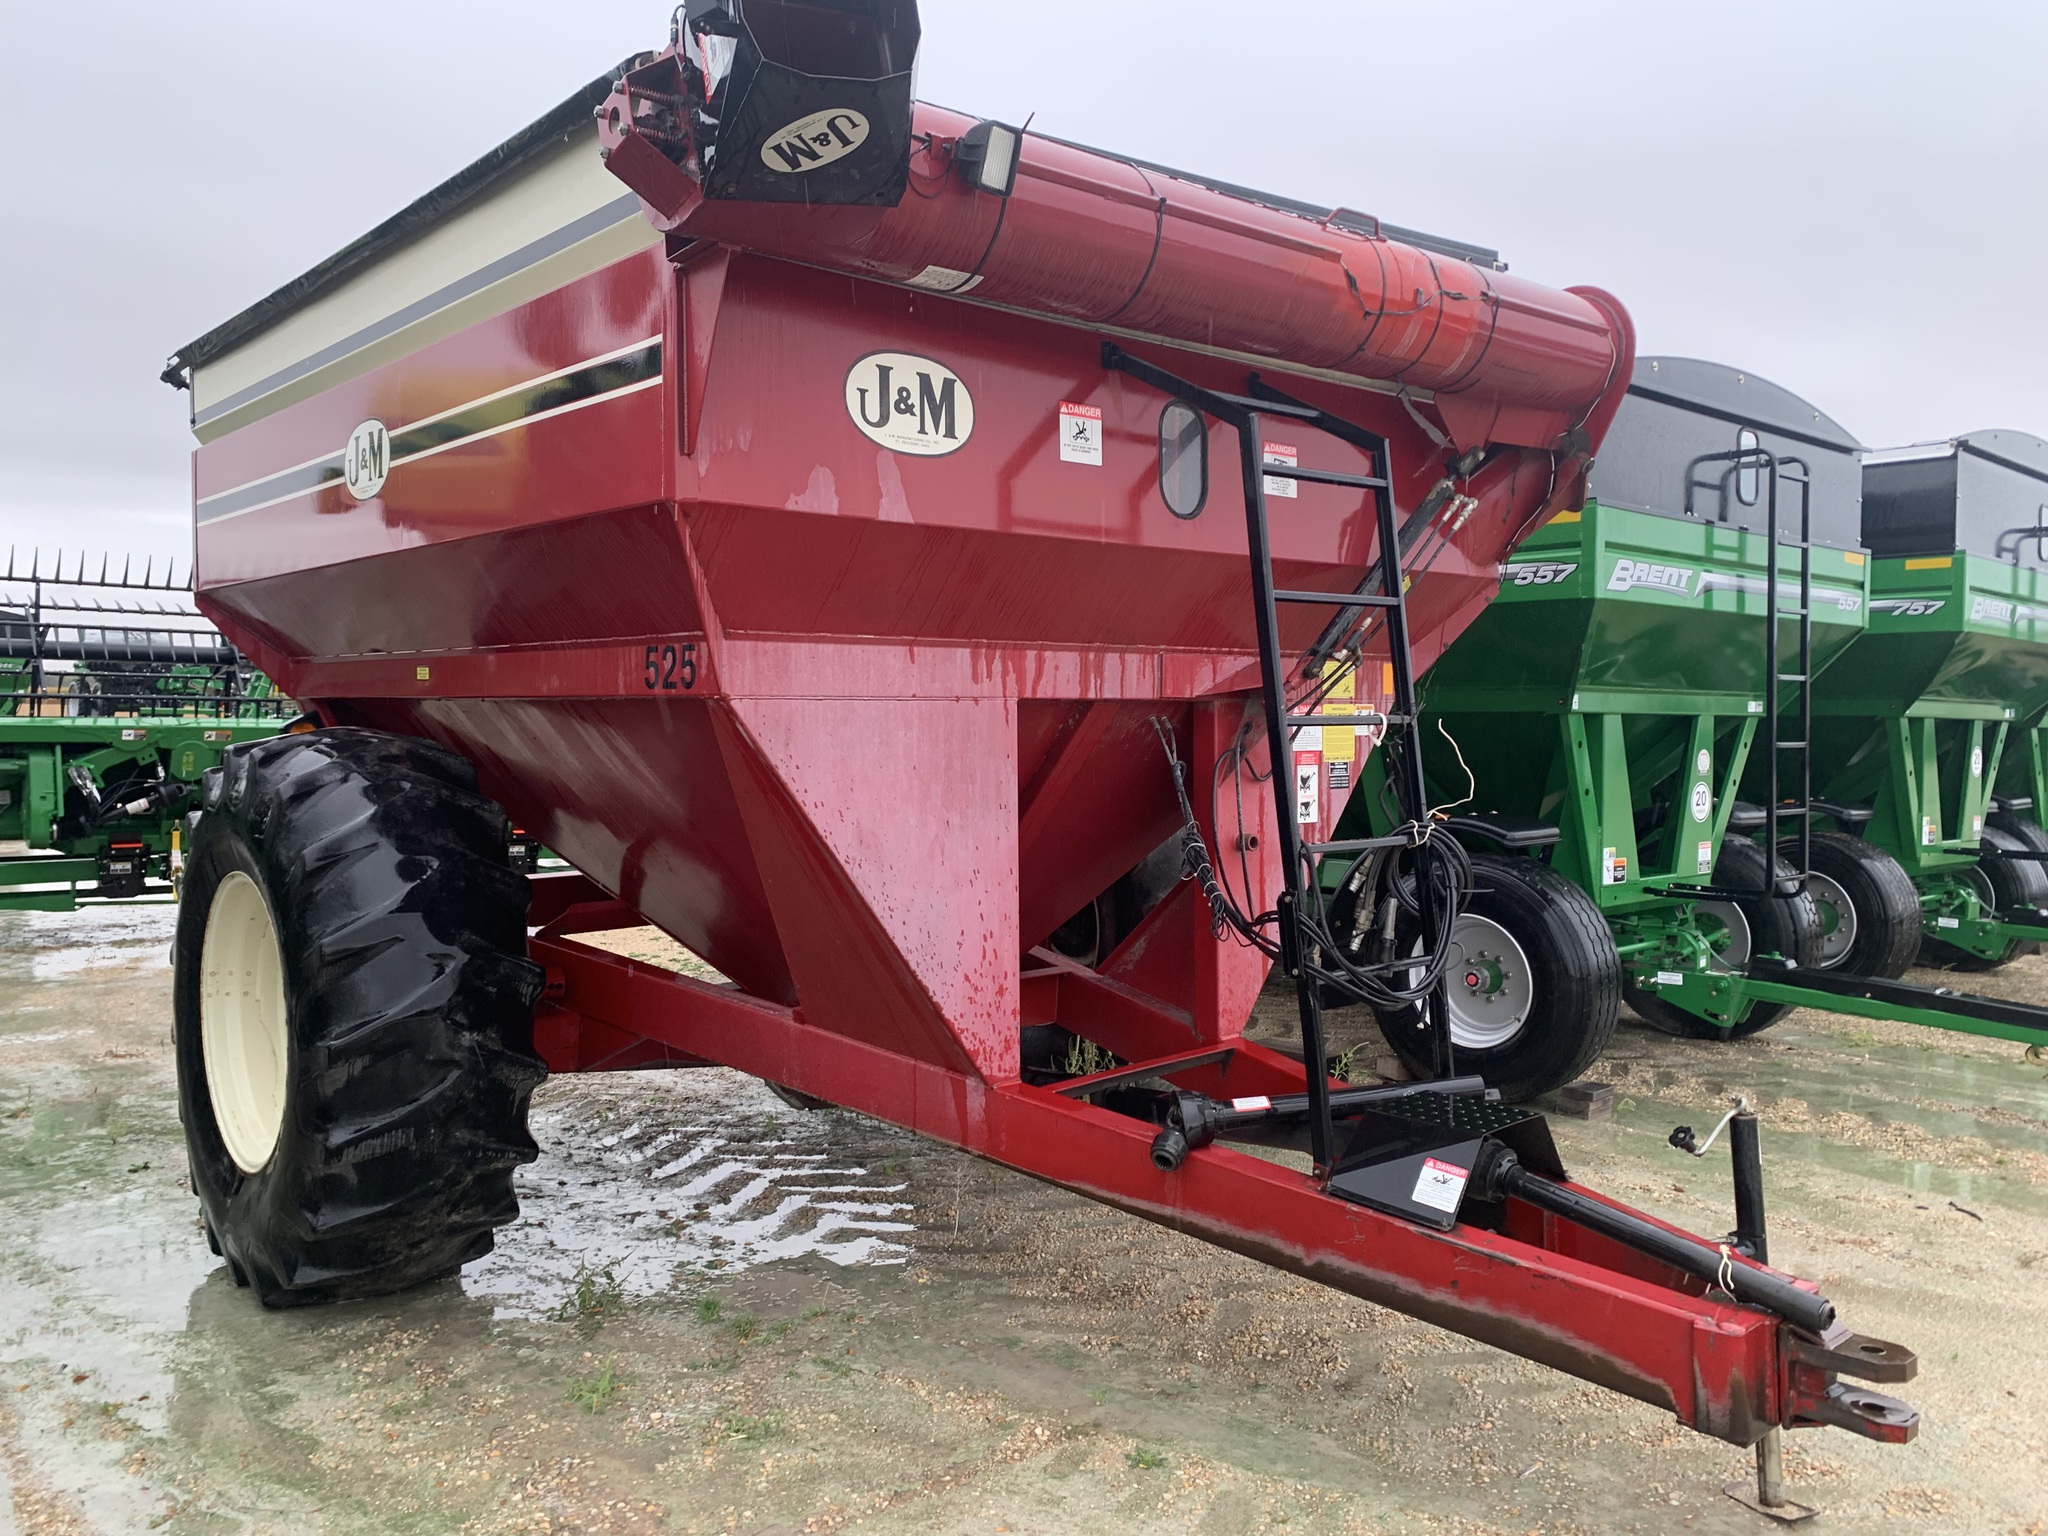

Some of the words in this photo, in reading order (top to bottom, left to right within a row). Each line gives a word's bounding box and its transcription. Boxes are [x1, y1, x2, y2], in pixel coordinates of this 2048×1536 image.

[769, 114, 861, 171] J&M
[857, 364, 958, 439] J&M
[1068, 404, 1101, 418] DANGER
[348, 428, 384, 486] J&M
[1271, 444, 1297, 455] DANGER
[1514, 563, 1579, 586] 557
[1606, 558, 1693, 592] BRENT
[1838, 596, 1862, 611] 557
[1891, 600, 1946, 616] 757
[1970, 597, 2014, 621] BRENT
[645, 644, 697, 689] 525
[1695, 790, 1707, 807] 20
[1435, 1162, 1466, 1176] DANGER
